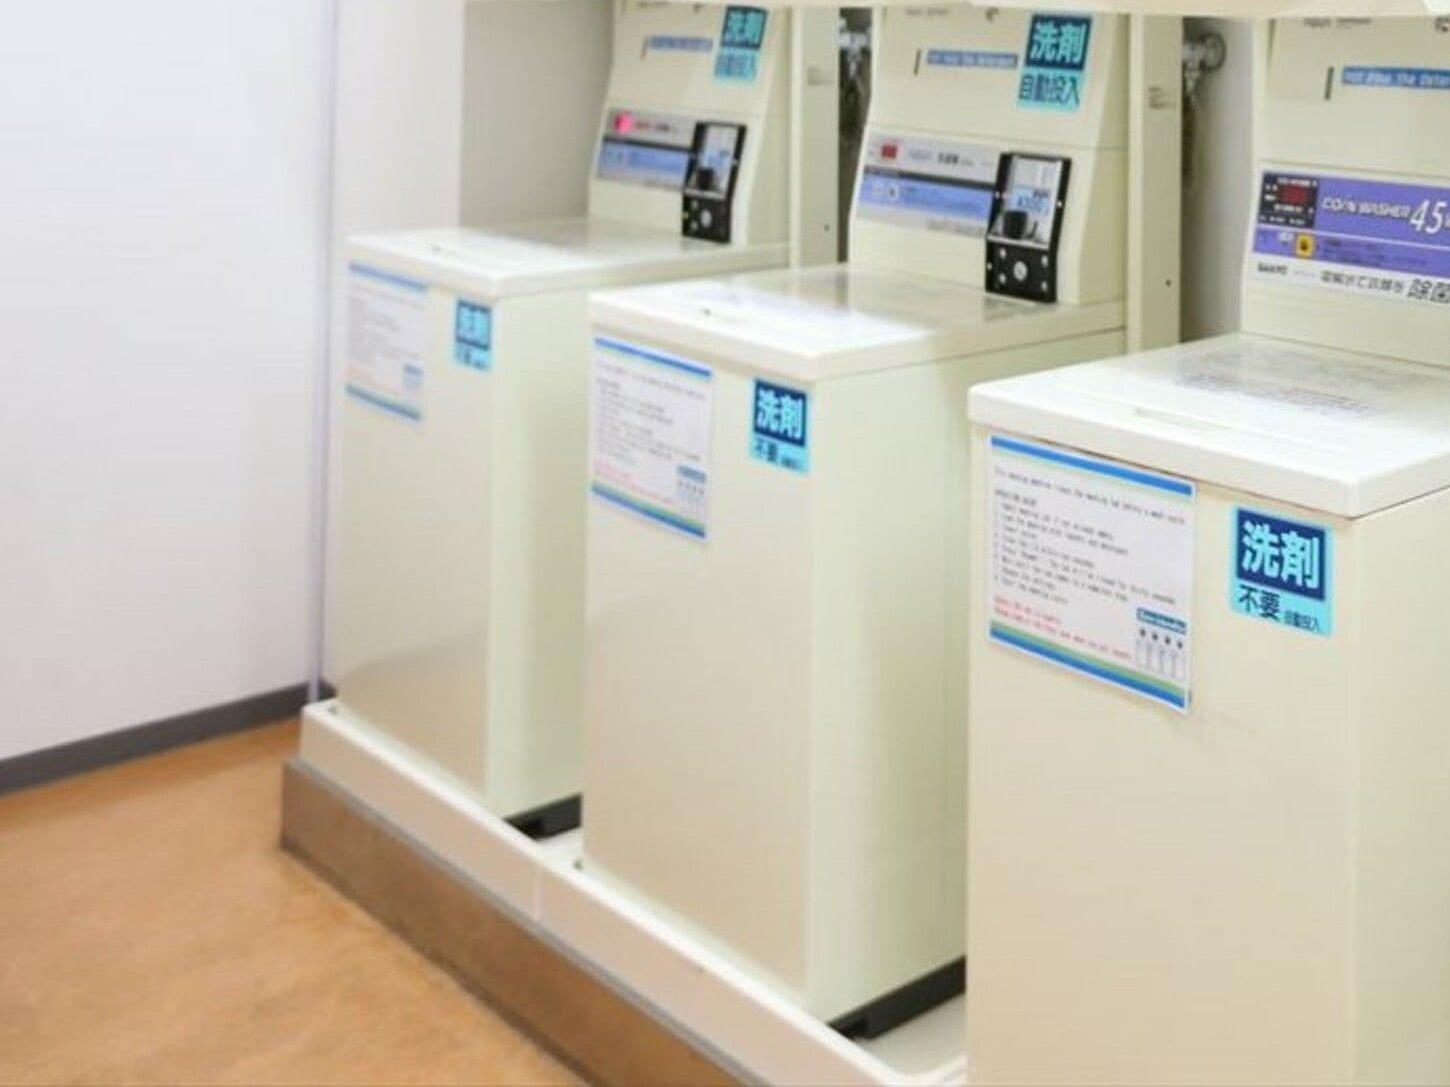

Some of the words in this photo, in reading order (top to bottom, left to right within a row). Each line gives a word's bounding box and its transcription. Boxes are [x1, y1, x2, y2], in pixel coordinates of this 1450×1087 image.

[1030, 22, 1087, 63] 洗剤
[757, 388, 803, 440] 洗剤
[1242, 520, 1319, 589] 洗剤
[1238, 584, 1281, 621] 不要
